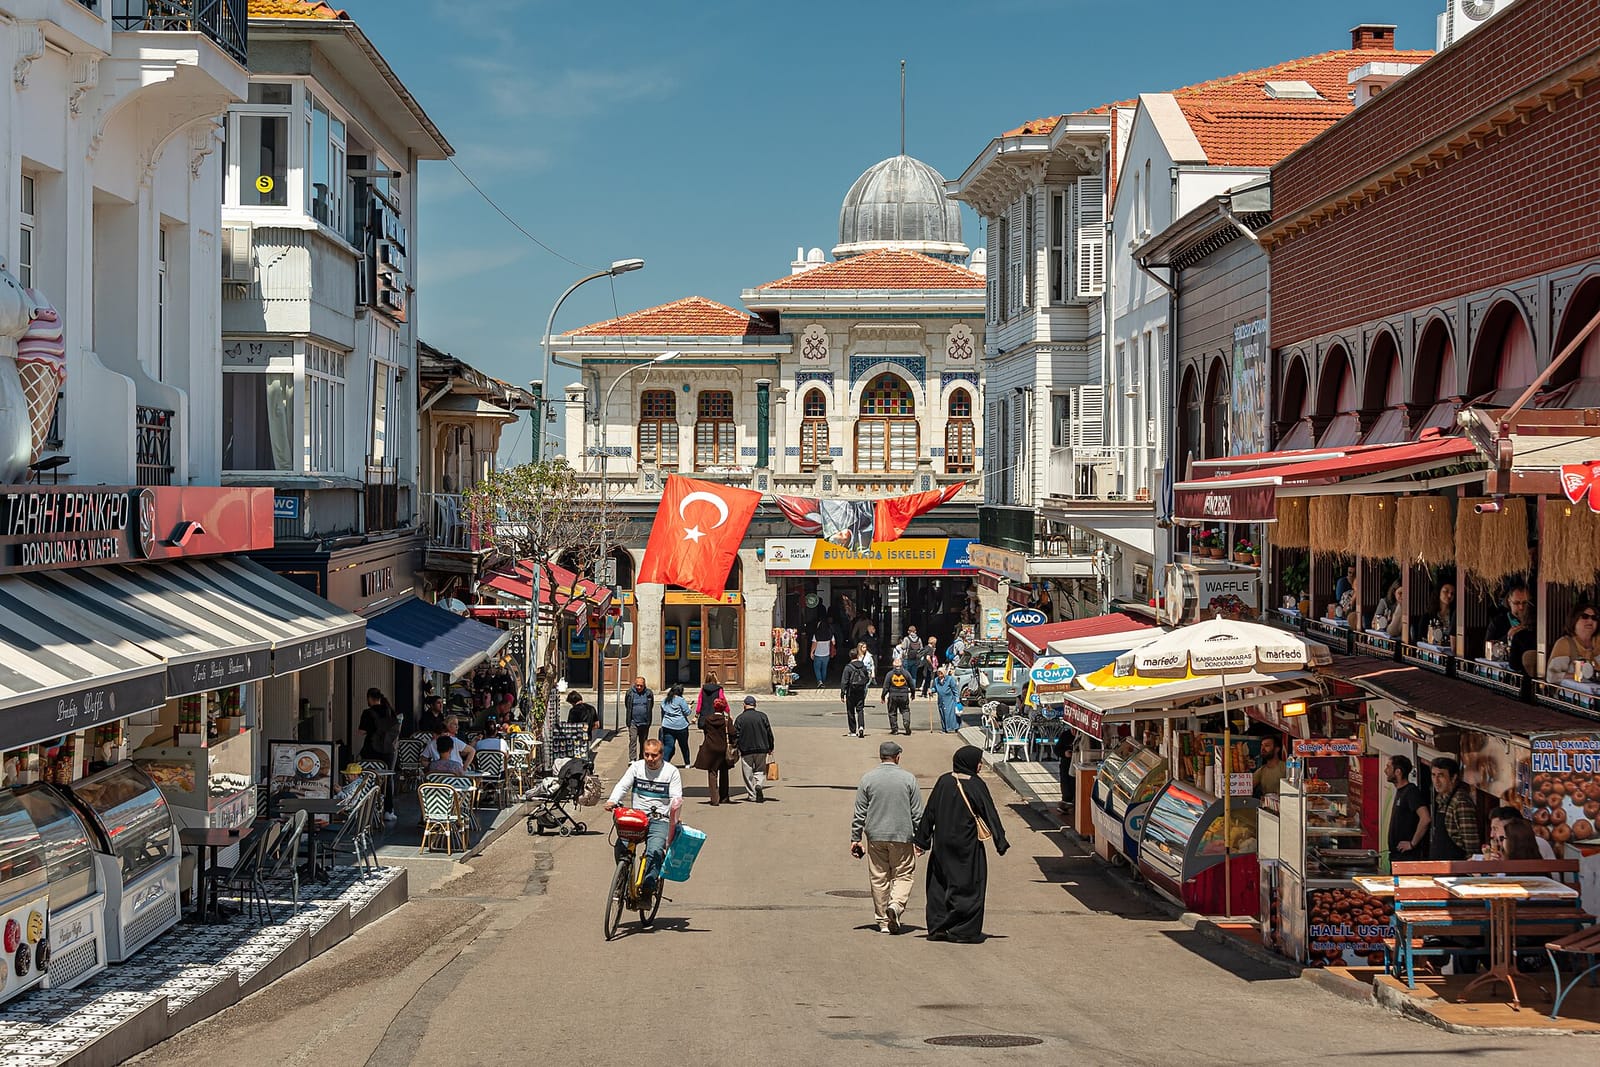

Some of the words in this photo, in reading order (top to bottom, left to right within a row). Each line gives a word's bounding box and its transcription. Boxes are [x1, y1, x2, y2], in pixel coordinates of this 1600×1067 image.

[260, 177, 269, 187] S
[274, 499, 294, 509] WC
[22, 540, 78, 566] DONDURMA
[80, 538, 87, 562] &
[87, 537, 119, 561] WAFFLE
[887, 547, 936, 560] İSKELESİ
[1205, 581, 1249, 592] WAFFLE
[1011, 613, 1041, 624] MADO
[1265, 645, 1302, 659] marfedo
[1143, 655, 1178, 667] marfedo
[1036, 670, 1069, 679] ROMA
[1533, 740, 1553, 750] ADA
[1532, 749, 1572, 773] HALİL
[1310, 922, 1354, 937] HALİL
[1357, 924, 1396, 937] USTA
